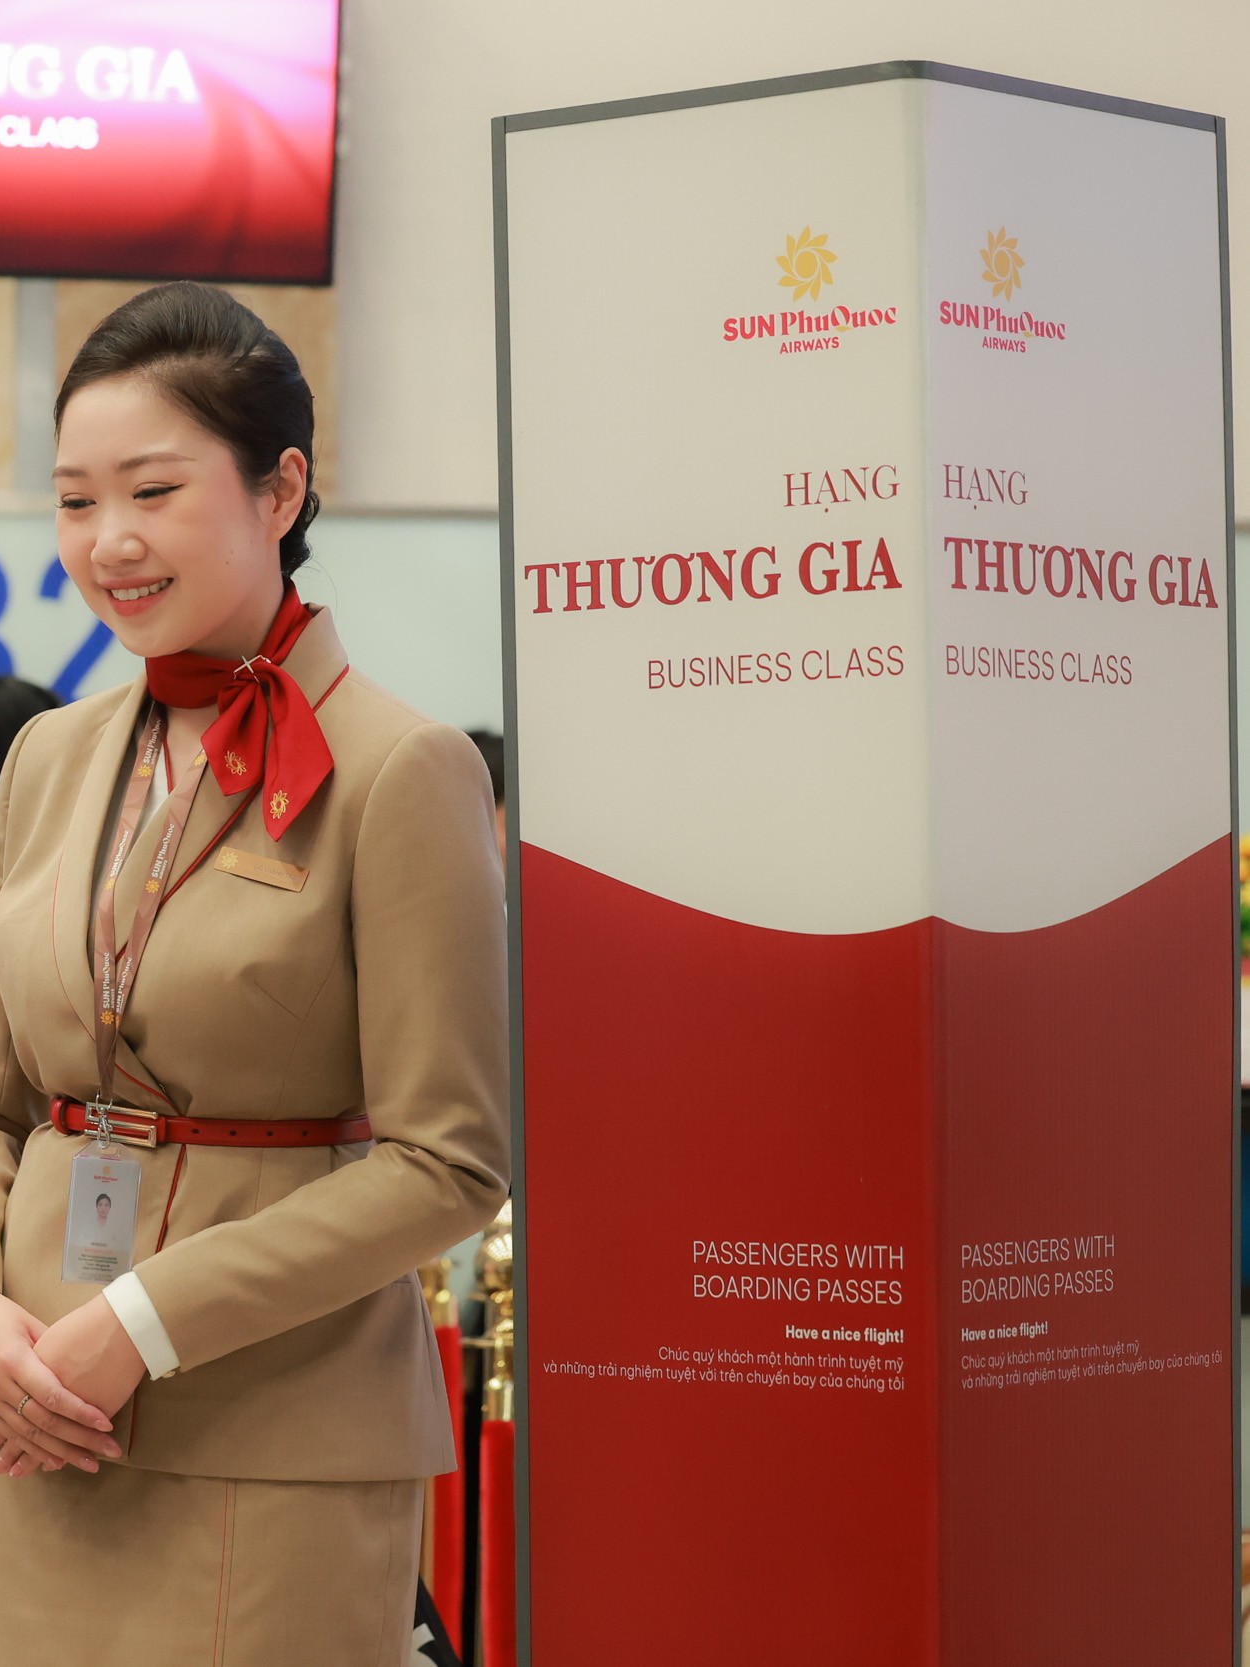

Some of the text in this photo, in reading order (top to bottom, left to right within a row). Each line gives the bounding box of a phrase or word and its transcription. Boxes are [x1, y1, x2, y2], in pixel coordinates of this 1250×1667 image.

[76, 45, 200, 104] GIA
[723, 305, 897, 341] SUN PhuQuoc
[940, 301, 1065, 340] SUN PhuQuoc
[780, 337, 840, 354] AIRWAYS
[982, 336, 1026, 353] AIRWAYS
[783, 464, 900, 513] HẠNG
[942, 464, 1028, 509] HẠNG
[524, 537, 902, 613] THƯƠNG GIA
[943, 536, 1219, 608] THƯƠNG GIA
[648, 645, 904, 689] BUSINESS CLASS
[945, 645, 1133, 686] BUSINESS CLASS
[151, 859, 163, 878] SUN
[103, 990, 111, 1009] SUN
[692, 1240, 904, 1270] PASSENGERS WITH
[960, 1235, 1115, 1268] PASSENGERS WITH
[693, 1274, 903, 1305] BOARDING PASSES
[961, 1268, 1114, 1304] BOARDING PASSES
[786, 1325, 904, 1345] Have a nice flight!
[962, 1321, 1048, 1342] Have a nice flight!
[658, 1346, 904, 1374] Chúc quý khách một hành trình tuyệt mỹ
[962, 1354, 986, 1370] Chúc
[988, 1352, 1006, 1369] quý
[1008, 1350, 1034, 1365] khách
[1057, 1346, 1079, 1360] hành
[1102, 1341, 1124, 1358] tuyệt
[962, 1376, 973, 1389] và
[1058, 1364, 1080, 1382] tuyệt
[1098, 1361, 1114, 1376] trên
[1149, 1357, 1165, 1372] bay
[1212, 1350, 1222, 1364] tôi
[543, 1360, 904, 1392] và những trải nghiệm tuyệt vời trên chuyến bay của chúng tôi
